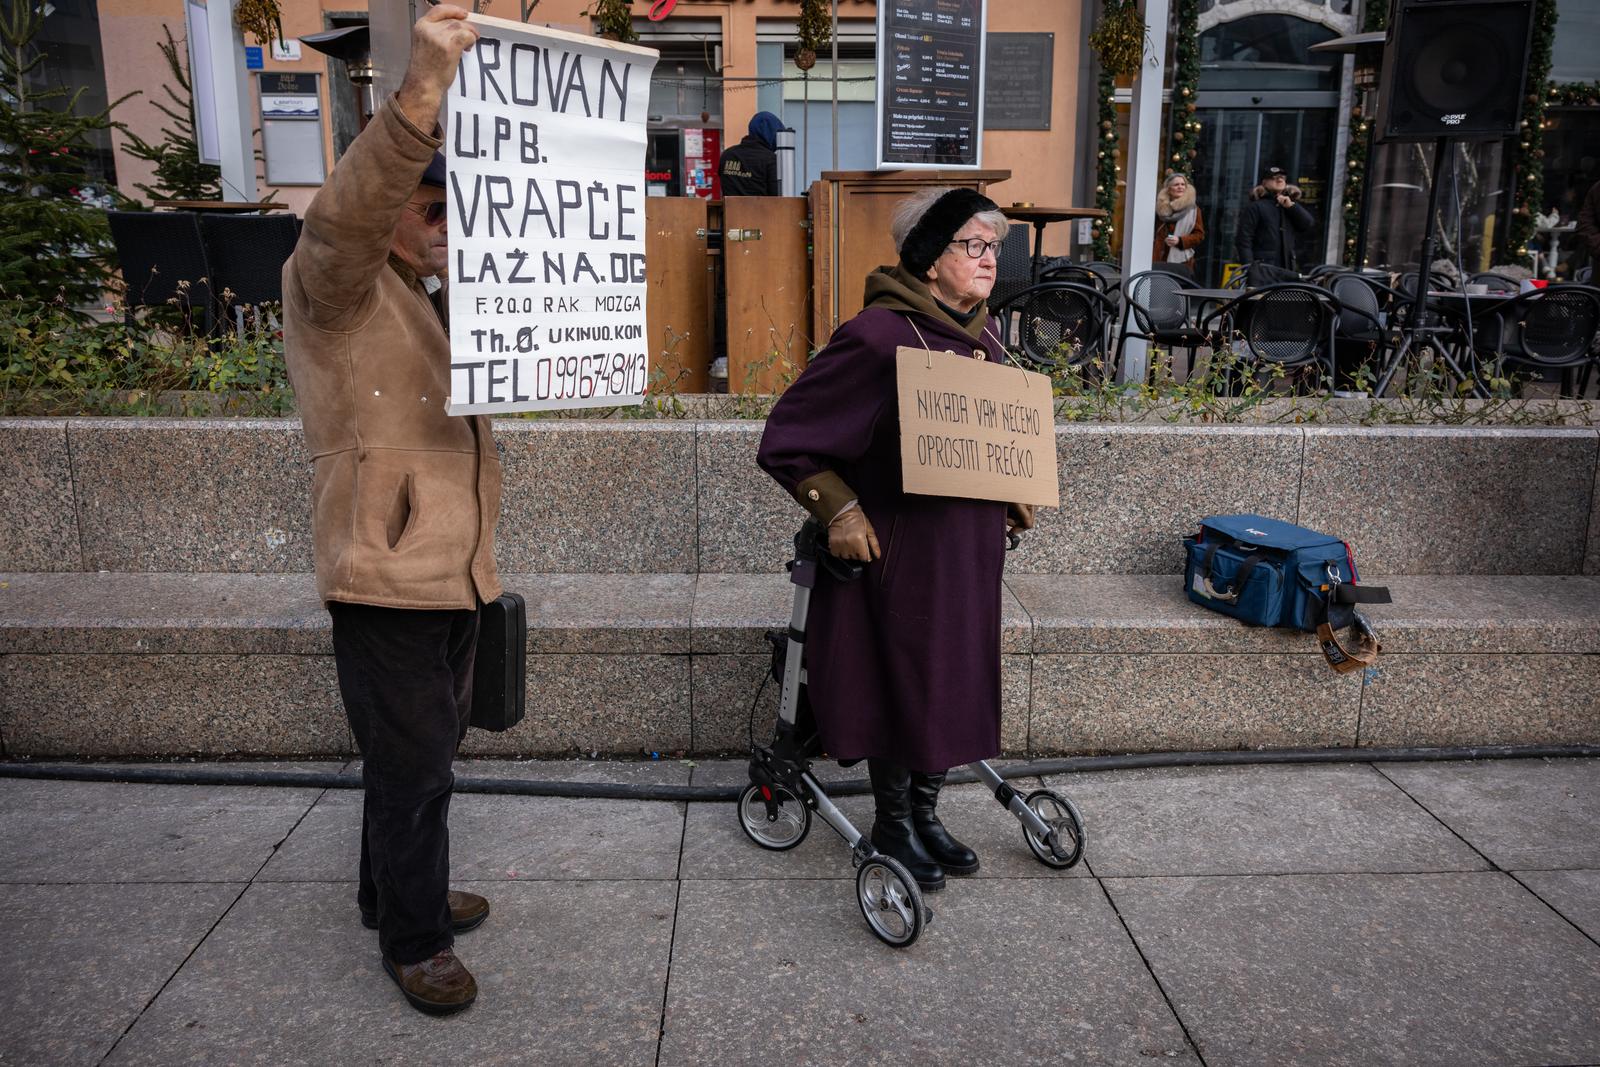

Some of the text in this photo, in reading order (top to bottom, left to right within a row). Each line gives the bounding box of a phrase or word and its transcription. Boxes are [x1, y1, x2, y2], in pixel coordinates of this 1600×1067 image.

[450, 171, 636, 241] VRAPČE
[544, 296, 580, 313] RAK
[595, 295, 641, 312] MOZGA
[451, 358, 530, 405] TEL
[917, 390, 1041, 436] NIKADA VAM NEĆEMO
[918, 434, 1034, 479] OPROSTITI PREČKO
